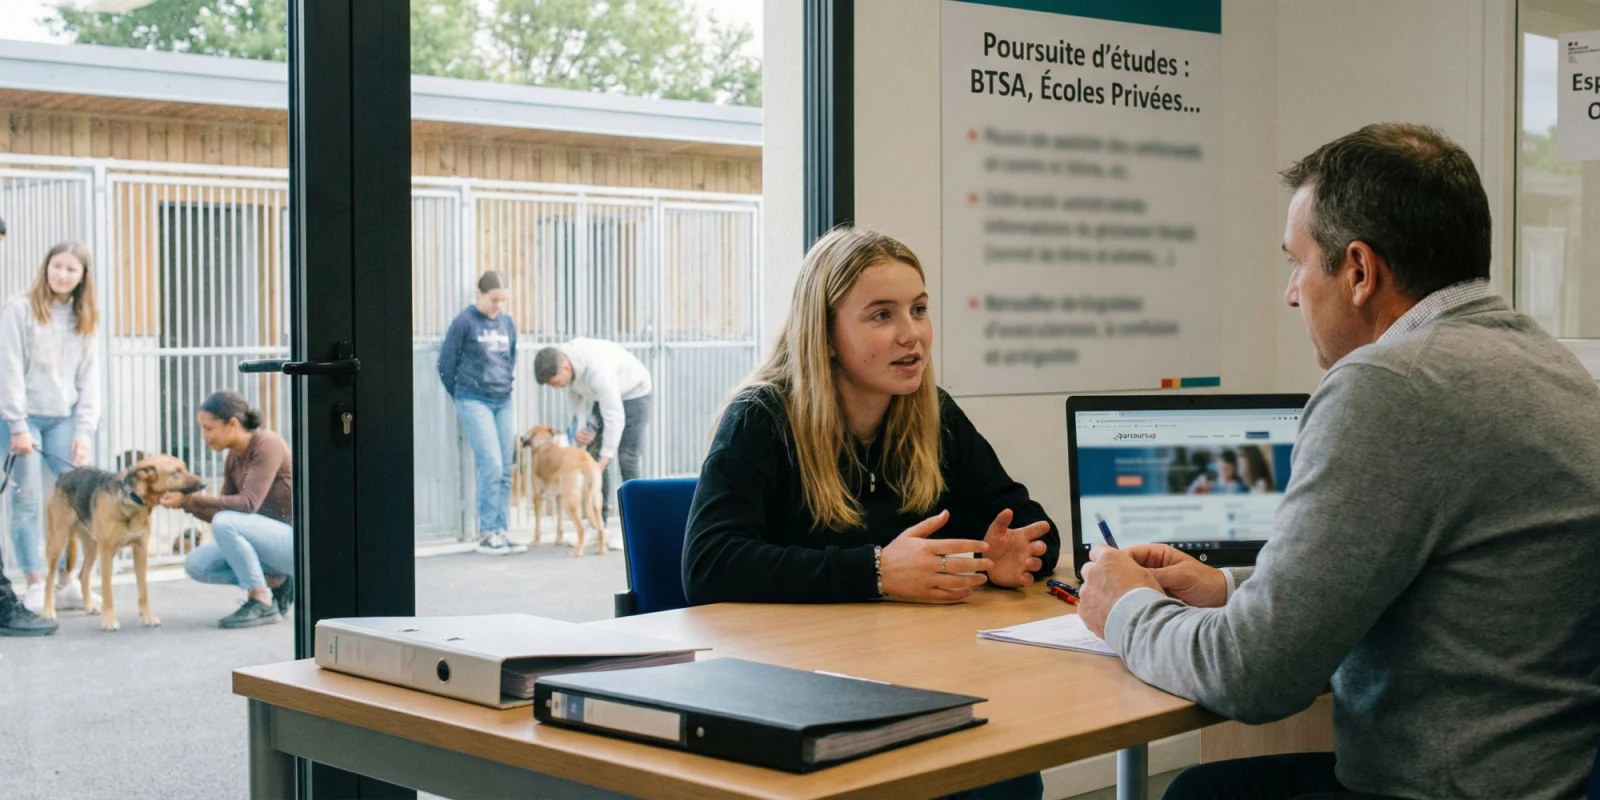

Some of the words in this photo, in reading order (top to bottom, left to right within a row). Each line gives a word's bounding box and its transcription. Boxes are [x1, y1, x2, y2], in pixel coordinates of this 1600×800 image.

[983, 31, 1085, 67] Poursuite
[1091, 43, 1178, 77] d’études
[1184, 59, 1190, 77] :
[970, 68, 1033, 103] BTSA,
[1040, 69, 1105, 105] Écoles
[1111, 82, 1201, 114] Privées...
[1118, 432, 1157, 441] parcoursup
